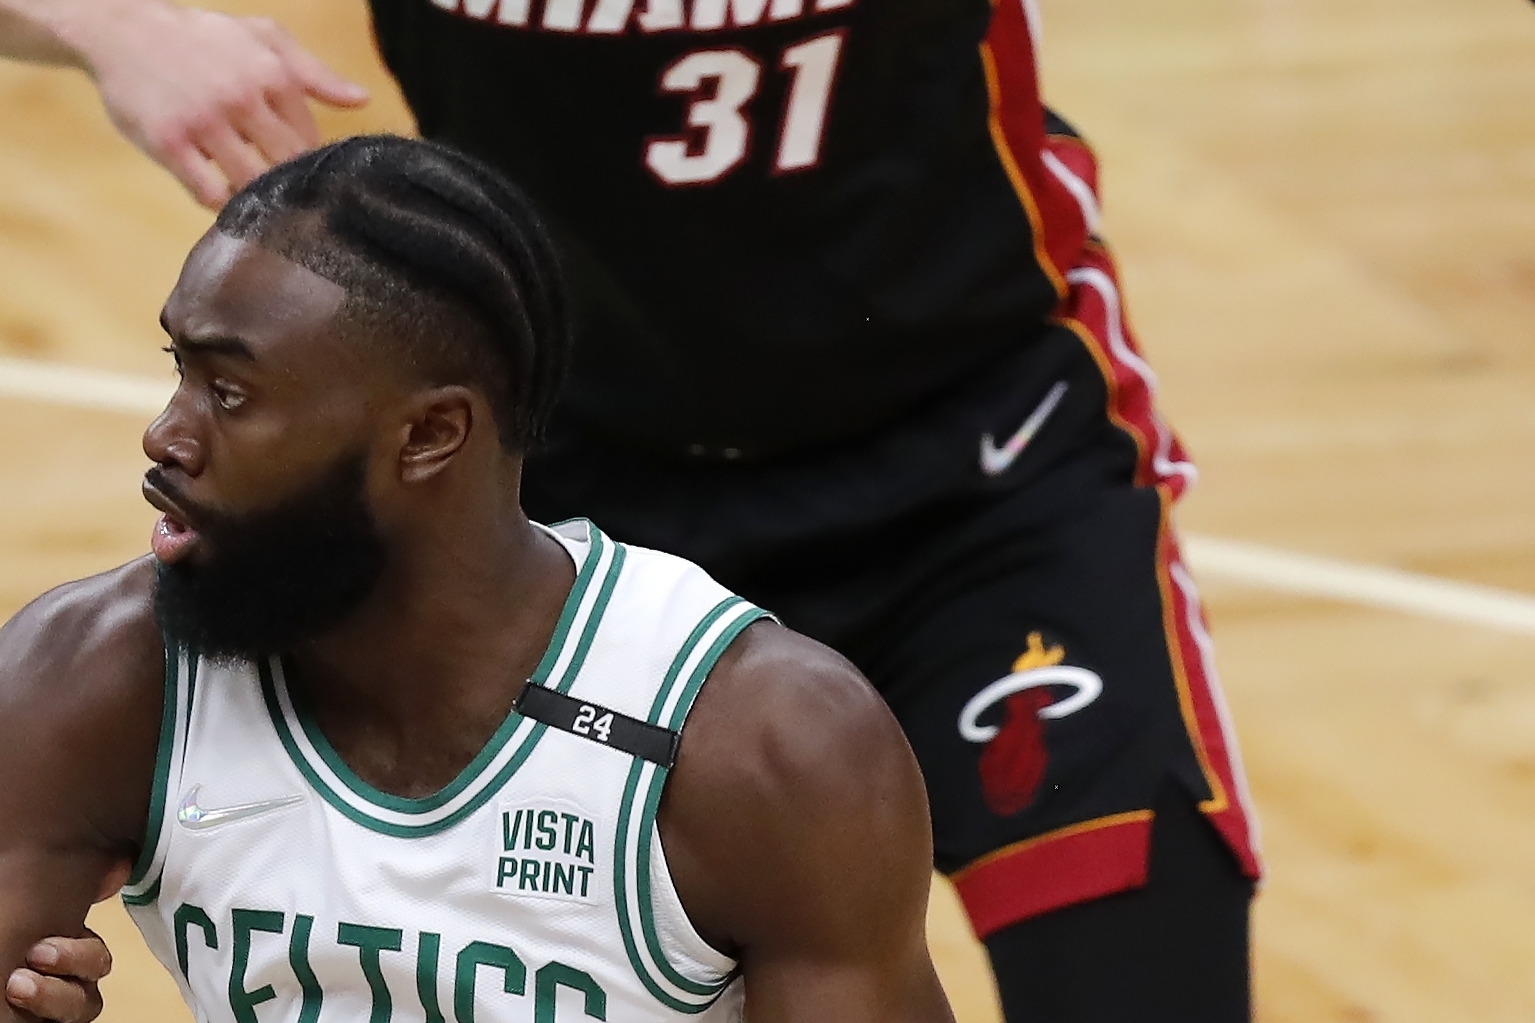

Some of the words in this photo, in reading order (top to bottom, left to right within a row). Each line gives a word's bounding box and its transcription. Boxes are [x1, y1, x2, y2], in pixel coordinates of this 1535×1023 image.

[643, 28, 849, 187] 31
[573, 704, 614, 742] 24
[502, 809, 595, 865] VISTA
[496, 856, 594, 898] PRINT
